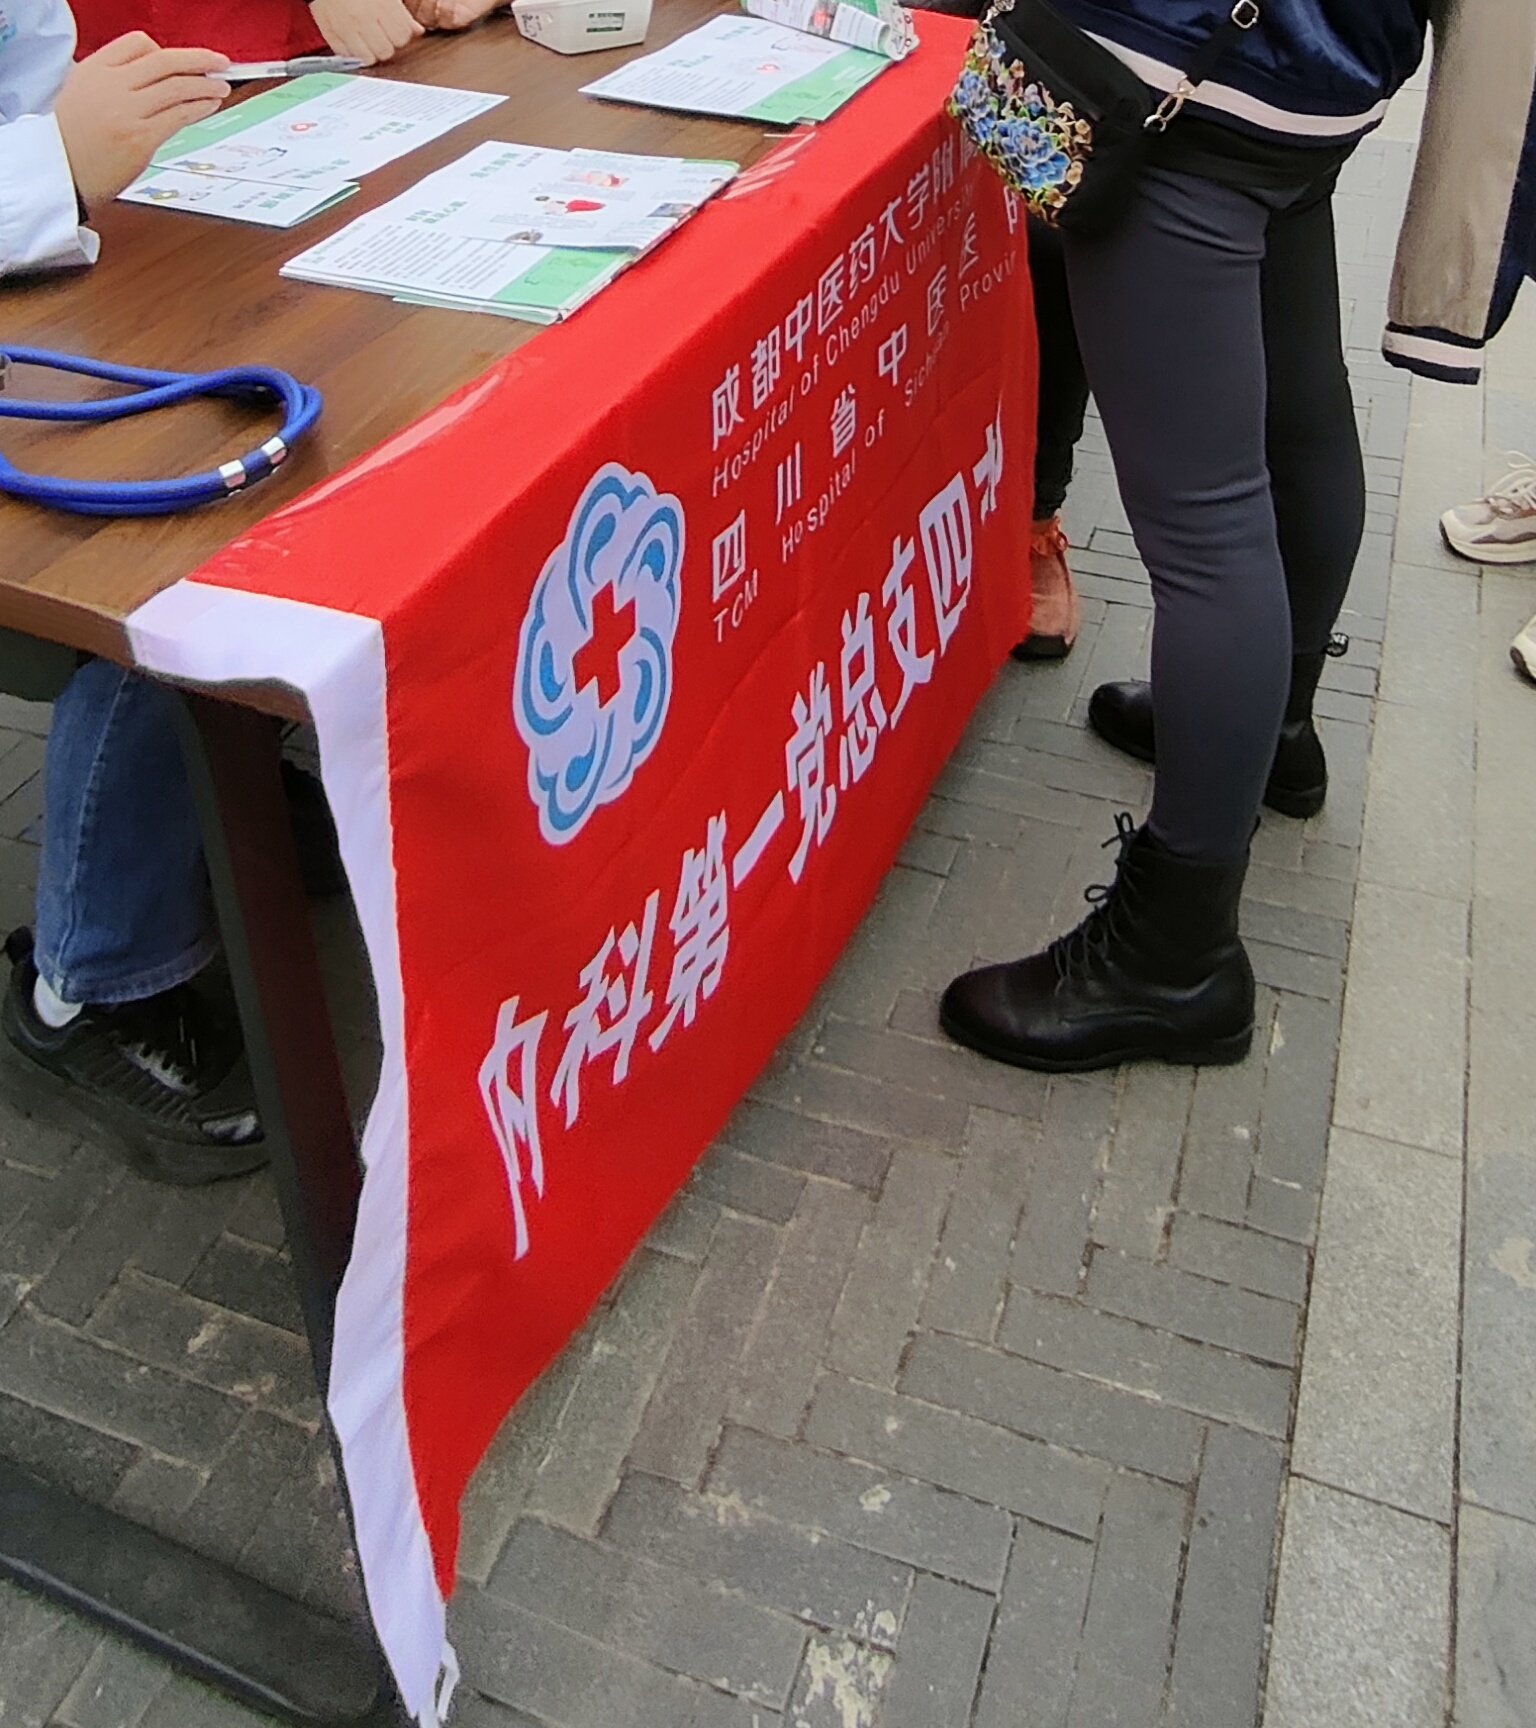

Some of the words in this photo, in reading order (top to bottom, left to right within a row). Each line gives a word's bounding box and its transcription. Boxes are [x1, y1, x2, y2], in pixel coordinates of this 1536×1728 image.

[713, 384, 794, 498] Hospital
[800, 353, 820, 396] of
[825, 272, 901, 367] Chengdu
[713, 568, 758, 643] TCM
[781, 447, 857, 564] Hospital
[864, 407, 885, 448] of
